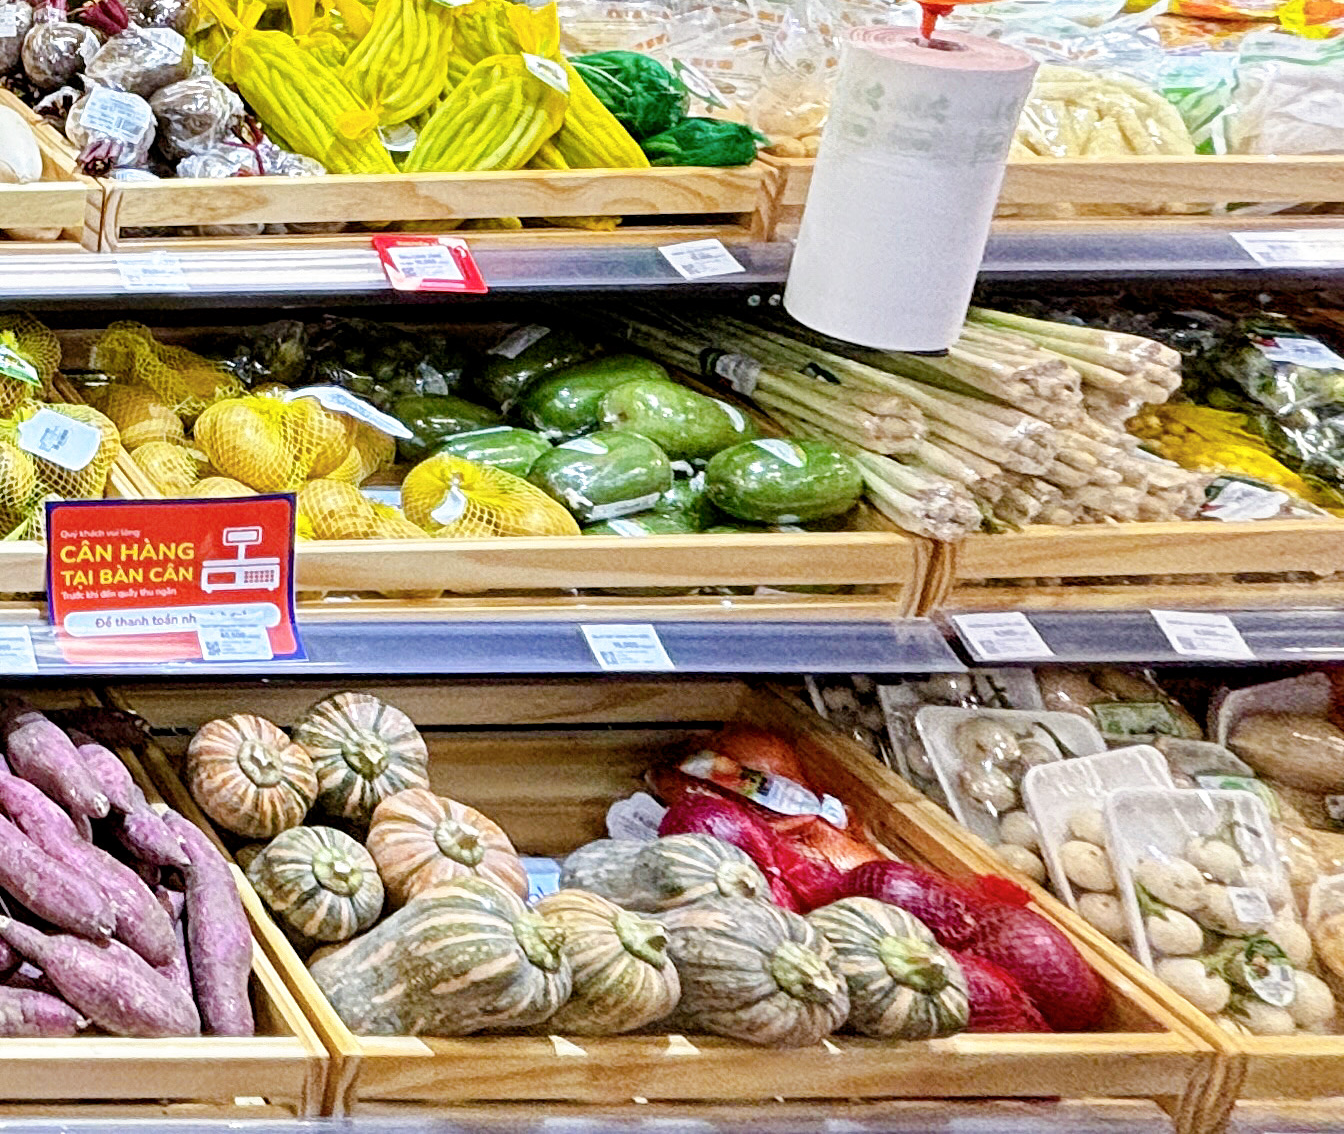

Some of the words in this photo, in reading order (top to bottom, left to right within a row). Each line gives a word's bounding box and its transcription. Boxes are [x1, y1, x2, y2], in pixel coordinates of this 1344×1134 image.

[60, 540, 112, 563] CÂN
[120, 538, 195, 561] HÀNG
[60, 569, 94, 590] TẠI
[99, 564, 144, 585] BÀN
[149, 563, 193, 582] CÂN
[95, 616, 112, 628] Để
[115, 617, 149, 626] thanh
[152, 613, 178, 625] toán
